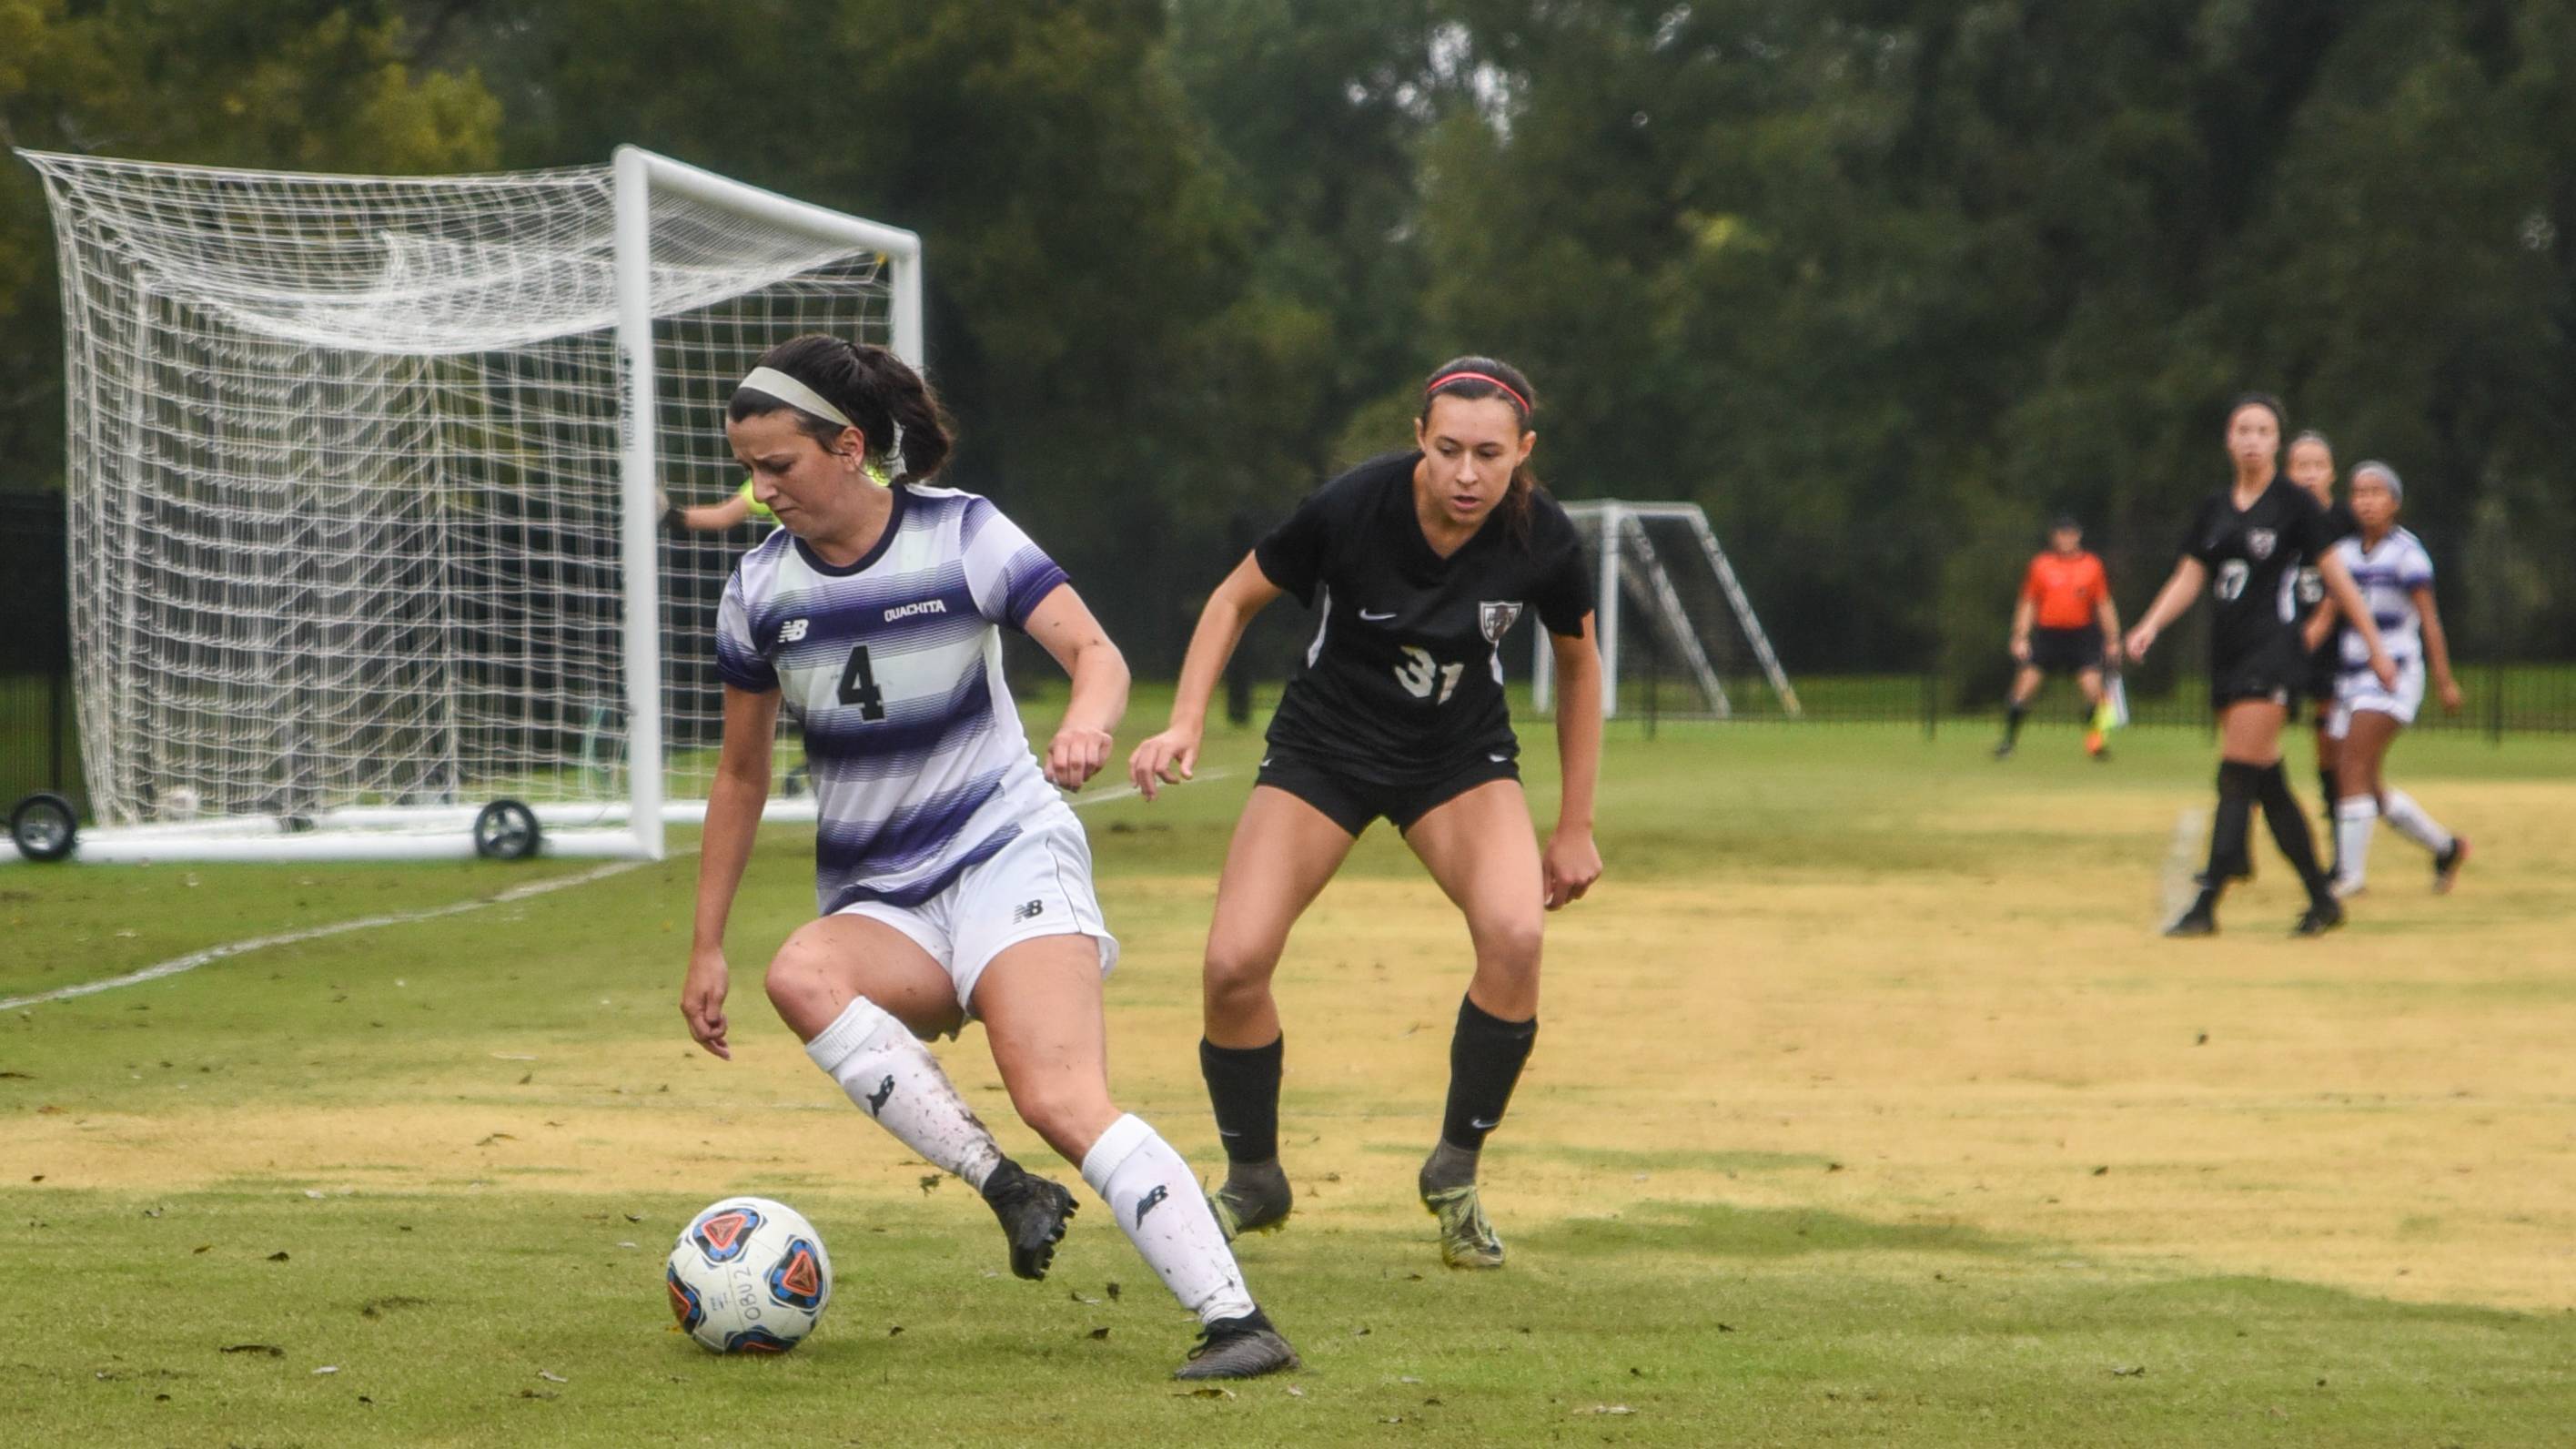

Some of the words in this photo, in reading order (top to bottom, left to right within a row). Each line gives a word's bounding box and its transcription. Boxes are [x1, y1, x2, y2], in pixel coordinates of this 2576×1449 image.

[884, 599, 946, 623] OUACHITA
[835, 641, 887, 724] 4
[1394, 644, 1465, 705] 31
[733, 1266, 753, 1280] 2
[738, 1283, 762, 1321] OBU
